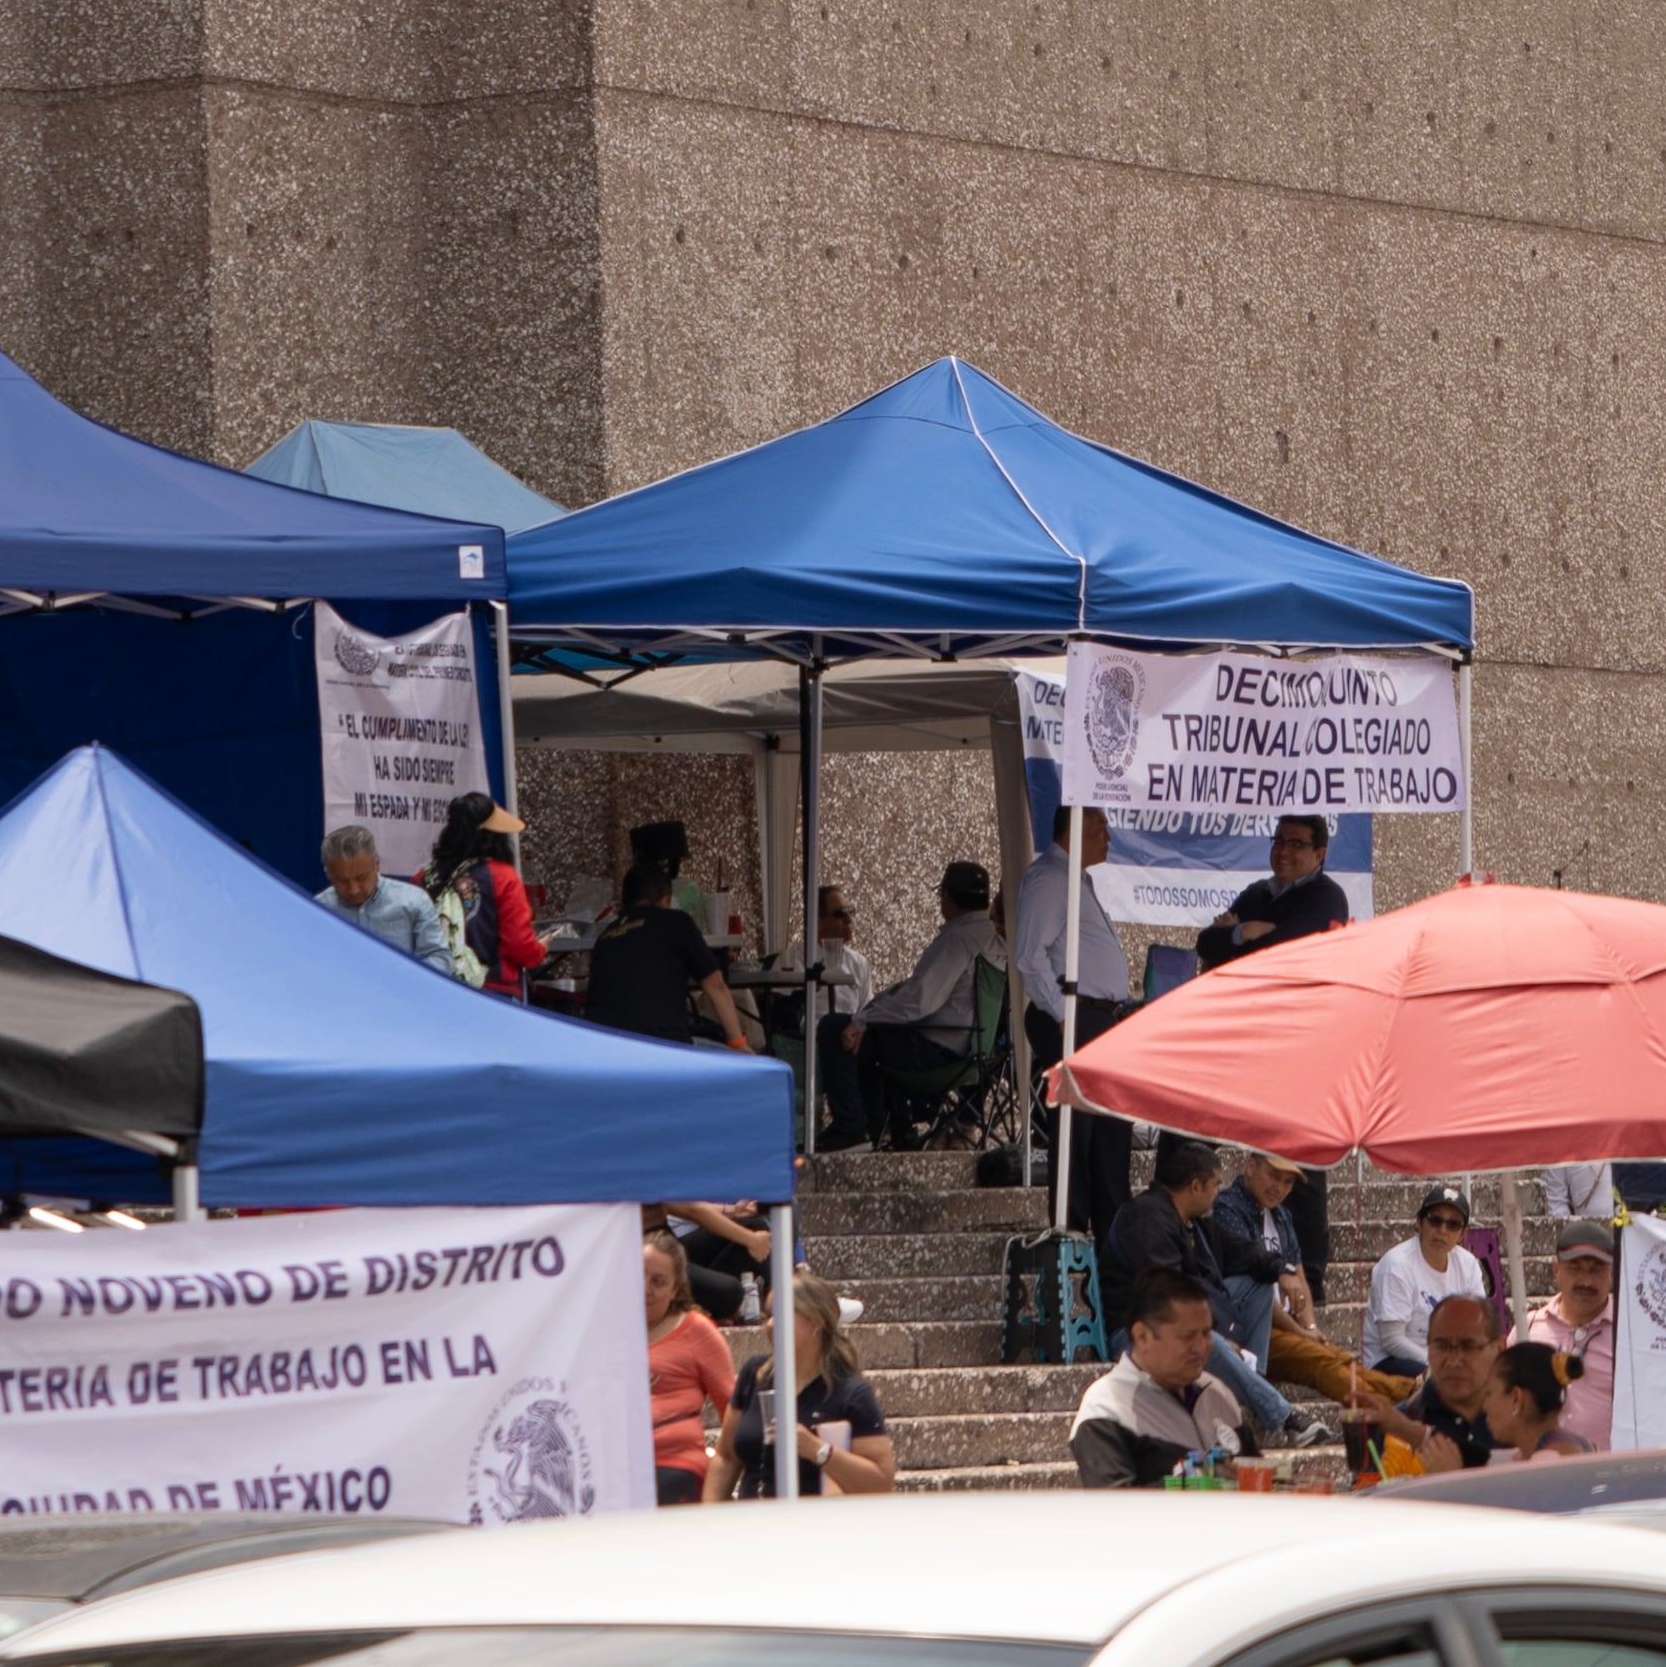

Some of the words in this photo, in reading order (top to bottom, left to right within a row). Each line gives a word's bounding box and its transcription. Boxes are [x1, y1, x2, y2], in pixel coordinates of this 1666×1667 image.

[1162, 713, 1301, 758] TRIBUNAL
[1304, 716, 1431, 756] COLEGIADO
[373, 756, 390, 780] HA
[393, 755, 420, 782] SIDO
[422, 758, 455, 785] SIEMPRE
[1147, 763, 1183, 802] EN
[1190, 764, 1298, 807] MATERIA
[1302, 767, 1347, 805] DE
[1354, 766, 1458, 805] TRABAJO
[354, 792, 368, 817] MI
[369, 794, 410, 821] ESPADA
[412, 796, 421, 821] Y
[1190, 812, 1228, 836] TUS
[58, 1268, 273, 1318] NOVENO
[283, 1260, 349, 1303] DE
[363, 1235, 565, 1296] DISTRITO
[129, 1357, 179, 1404] DE
[193, 1343, 367, 1400] TRABAJO
[380, 1338, 432, 1384] EN
[443, 1334, 498, 1377] LA
[233, 1464, 392, 1512] MÉXICO
